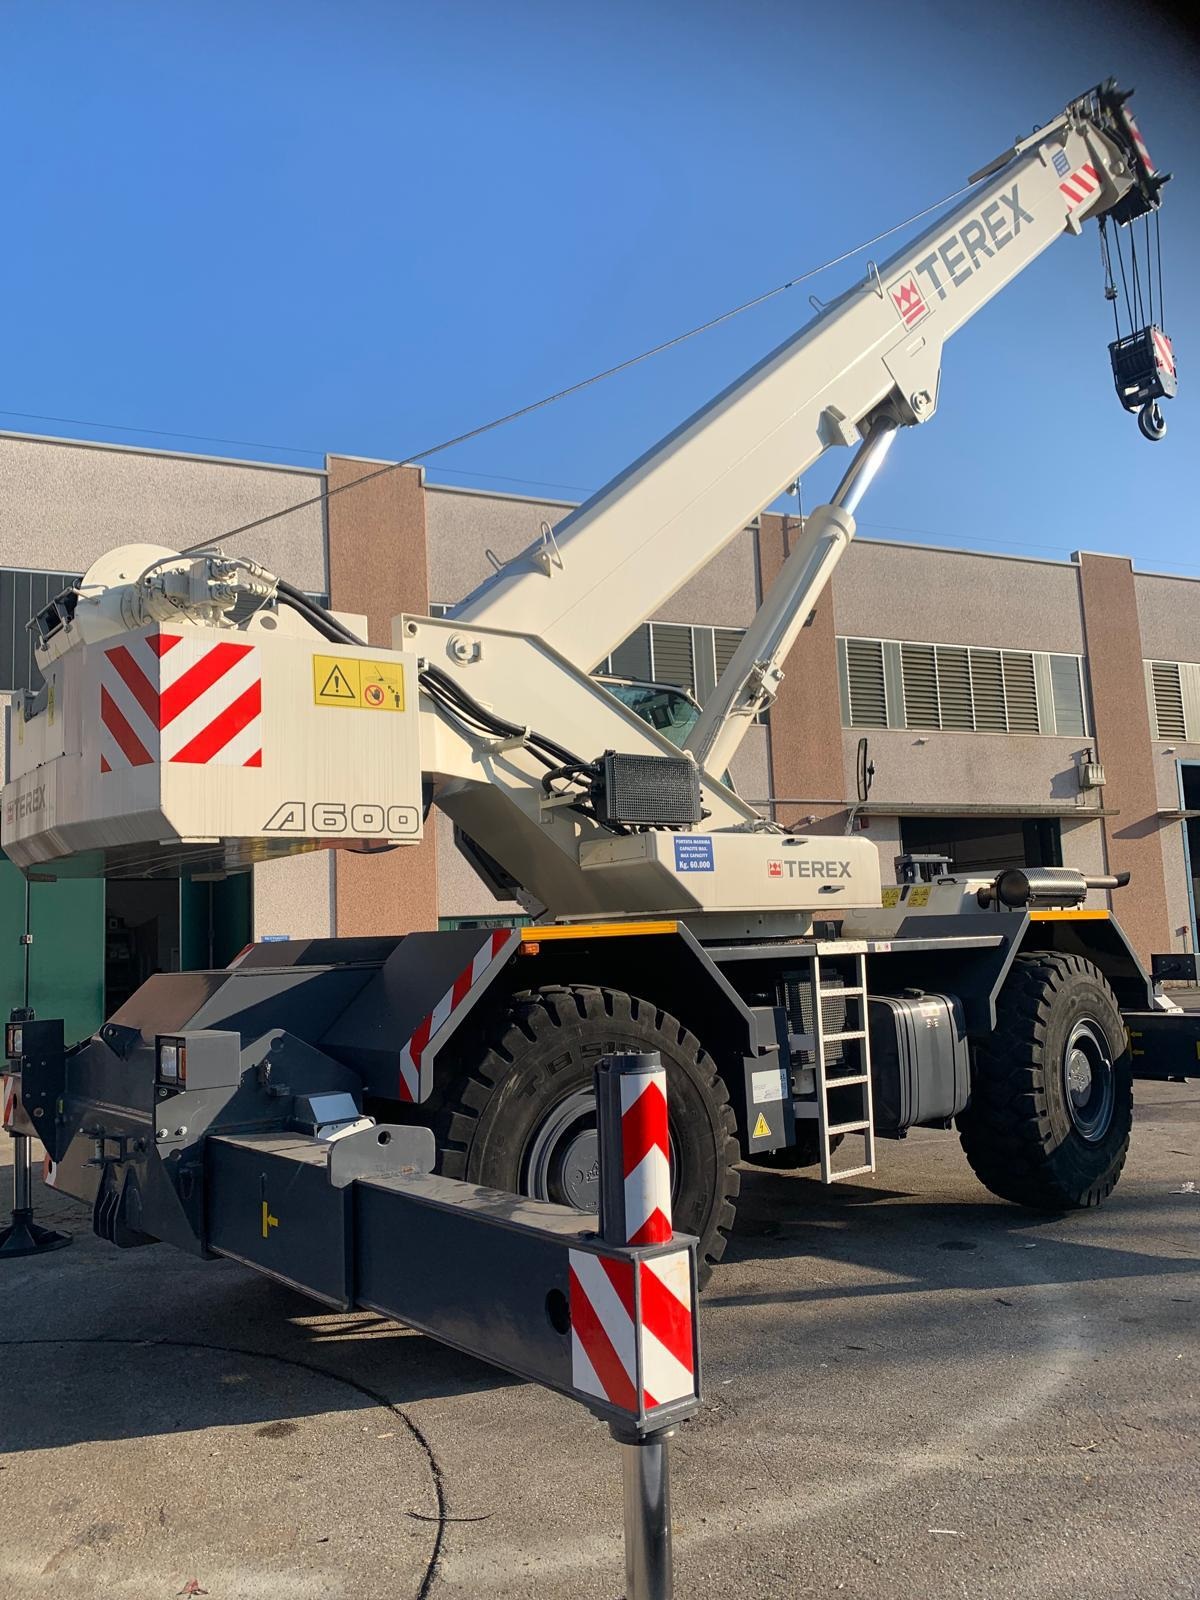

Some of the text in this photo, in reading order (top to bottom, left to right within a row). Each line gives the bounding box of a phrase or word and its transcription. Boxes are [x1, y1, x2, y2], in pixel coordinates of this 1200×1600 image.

[914, 183, 1035, 301] TEREX
[15, 783, 46, 821] TEREX
[261, 801, 420, 834] A600
[680, 861, 689, 870] Kg.
[784, 860, 852, 878] TEREX
